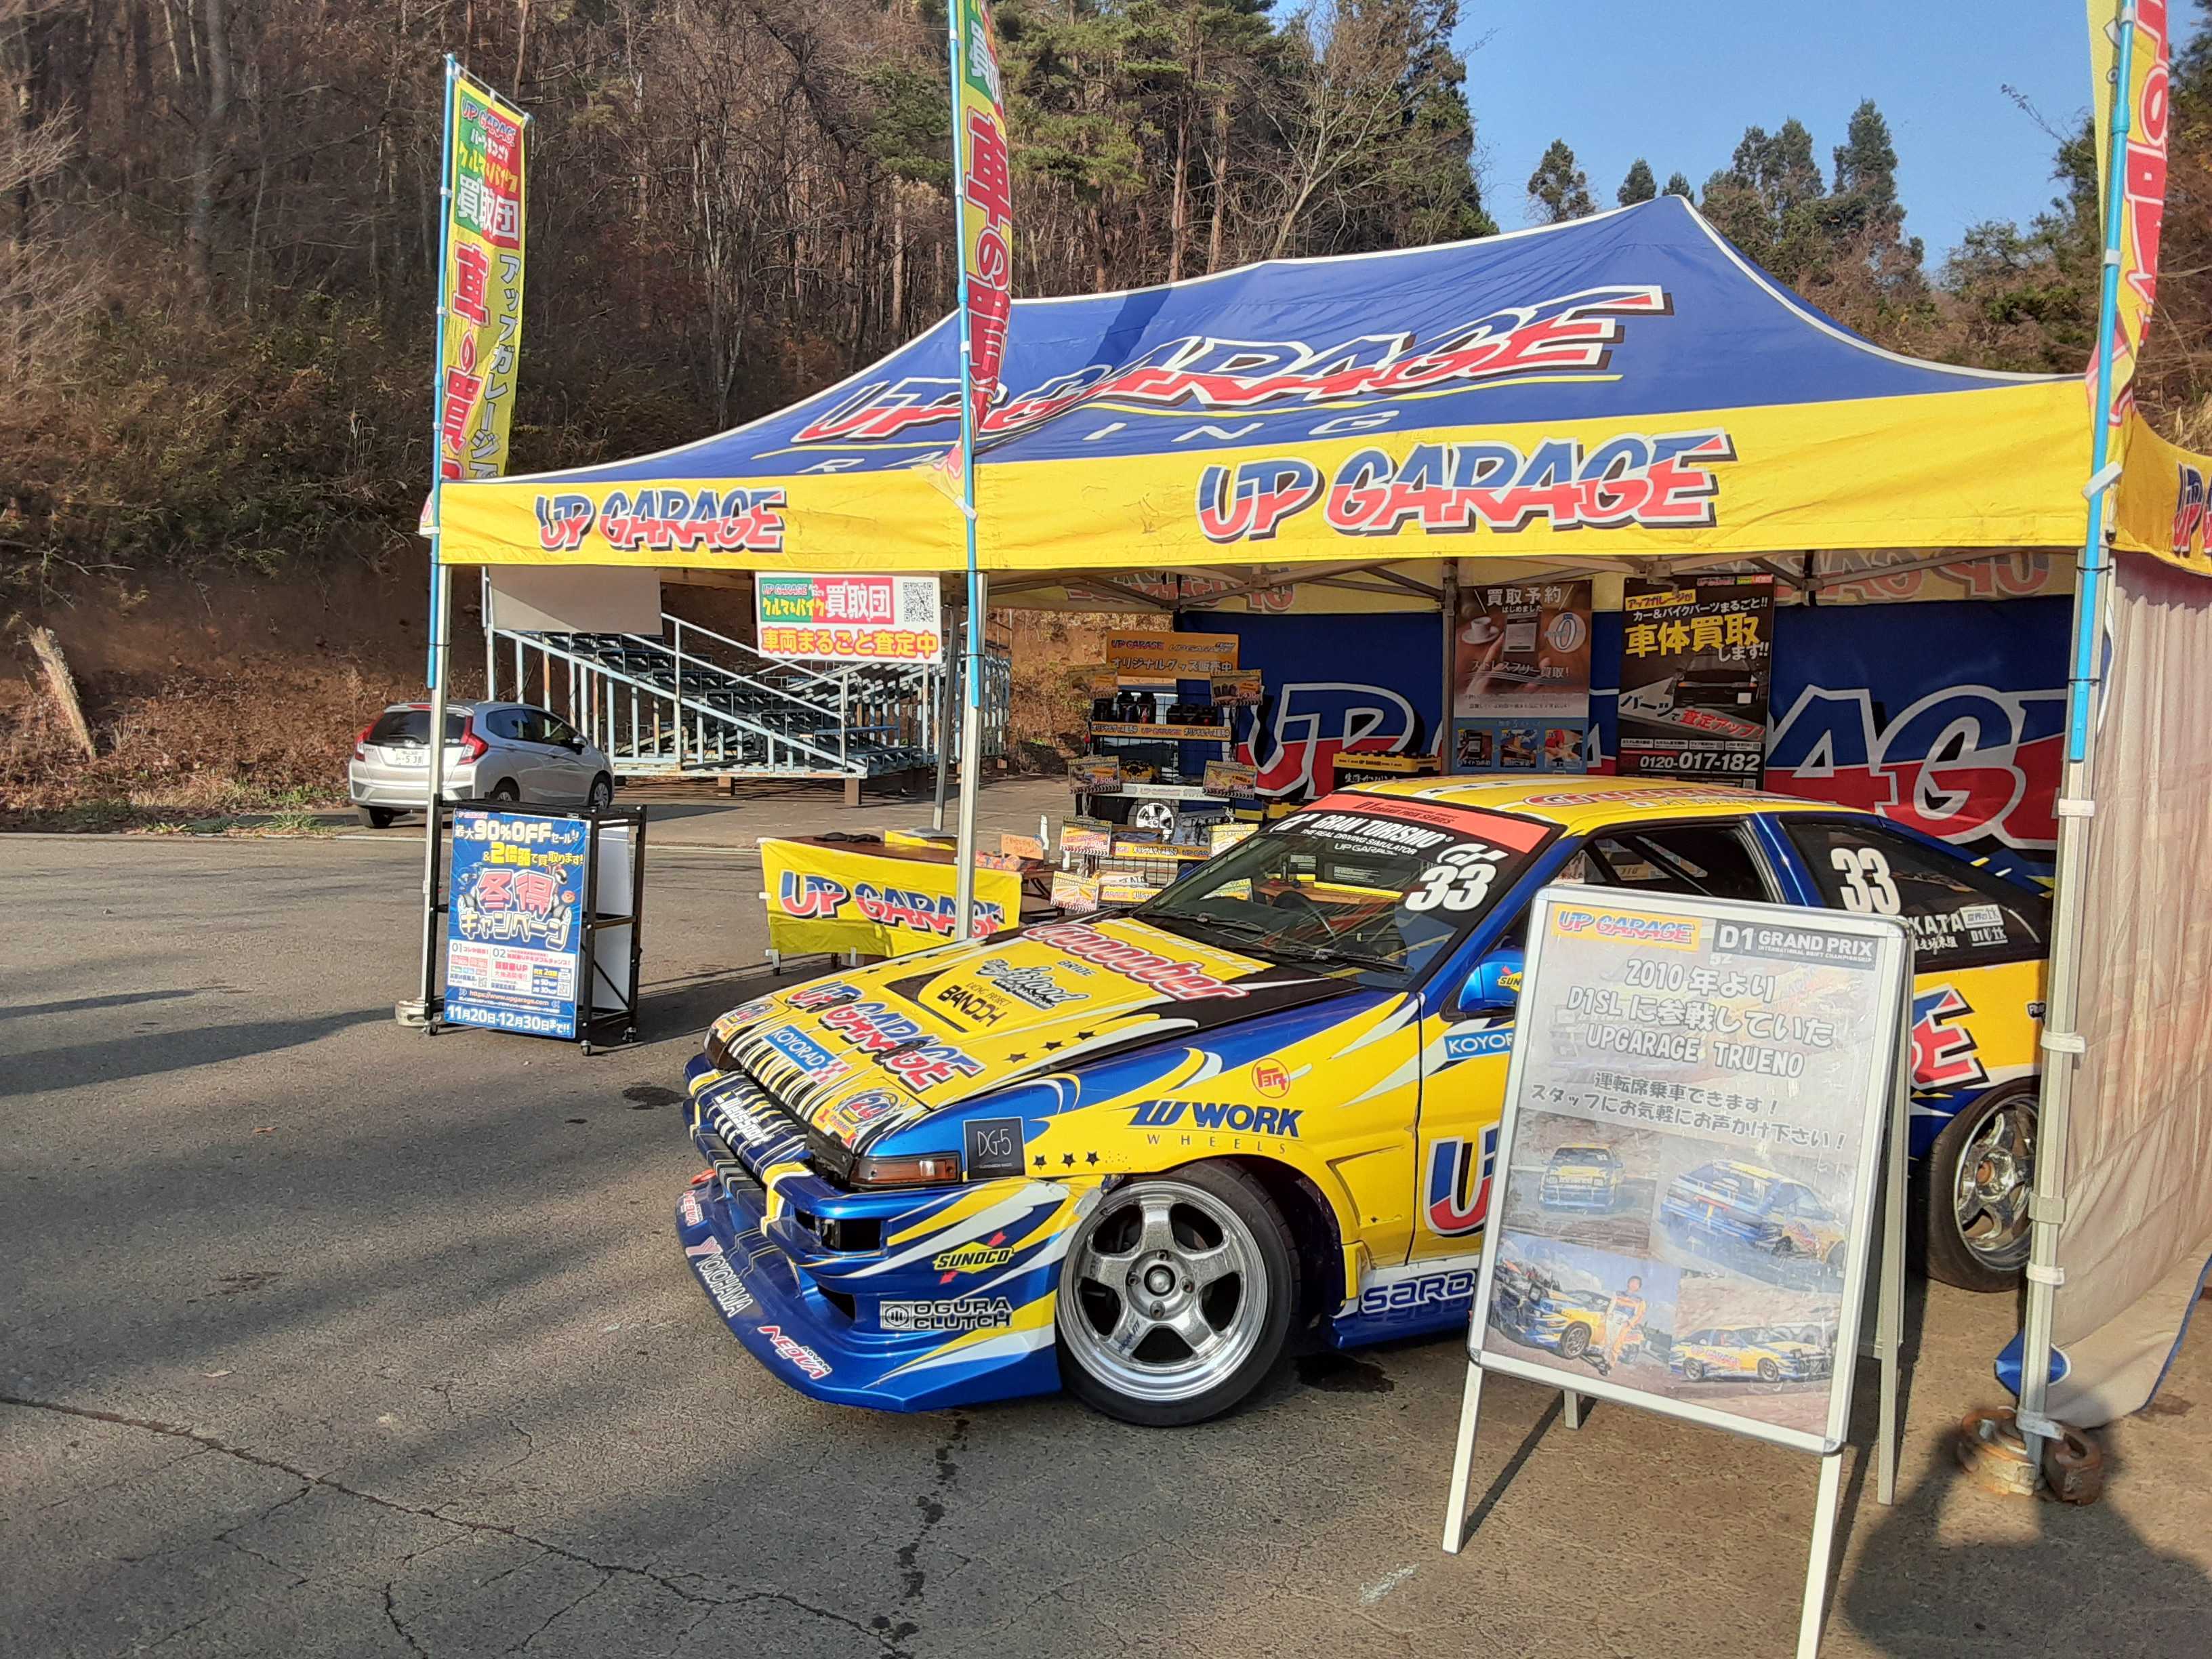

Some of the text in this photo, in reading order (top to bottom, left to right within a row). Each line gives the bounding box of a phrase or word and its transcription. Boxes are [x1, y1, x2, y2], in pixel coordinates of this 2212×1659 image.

[458, 173, 520, 242] 買取団
[966, 106, 1012, 437] 車の買
[794, 409, 1400, 473] RAING
[1194, 427, 1737, 544] UP GARAGE
[535, 486, 787, 553] UP GARAGE
[762, 583, 774, 595] UP
[826, 580, 891, 622] 買取団
[1487, 586, 1562, 606] 買取予約
[760, 626, 939, 659] 車両まるごと査定中
[1624, 612, 1761, 658] 車体買取
[1719, 641, 1769, 662] します!!
[1639, 752, 1761, 772] 0120-017-182
[1311, 814, 1448, 848] GRAN TURISMO
[1334, 842, 1352, 851] UP
[1366, 838, 1418, 855] SIMULATOR
[780, 870, 851, 918] UP
[1406, 863, 1497, 910] 33
[1830, 847, 1902, 915] 33
[459, 907, 572, 951] キャンペーン
[1557, 910, 1695, 944] UP GARAGE
[1718, 925, 1875, 958] D1 GRAND PRIX
[493, 948, 506, 958] 02
[1057, 959, 1097, 977] BRIDE
[770, 1027, 827, 1067] KOYORAD
[785, 981, 987, 1092] UP GARAGE
[1586, 1024, 1805, 1079] UPGARAGE TRUENO
[1191, 1101, 1305, 1139] WORK
[1146, 1133, 1288, 1155] WHEELS
[937, 1248, 1011, 1269] SUNOCO
[697, 1251, 754, 1317] YOKOHAMA
[913, 1297, 1012, 1315] OGURA
[913, 1312, 1012, 1330] CLUTCH
[757, 1326, 832, 1380] ADVAN NEOVA
